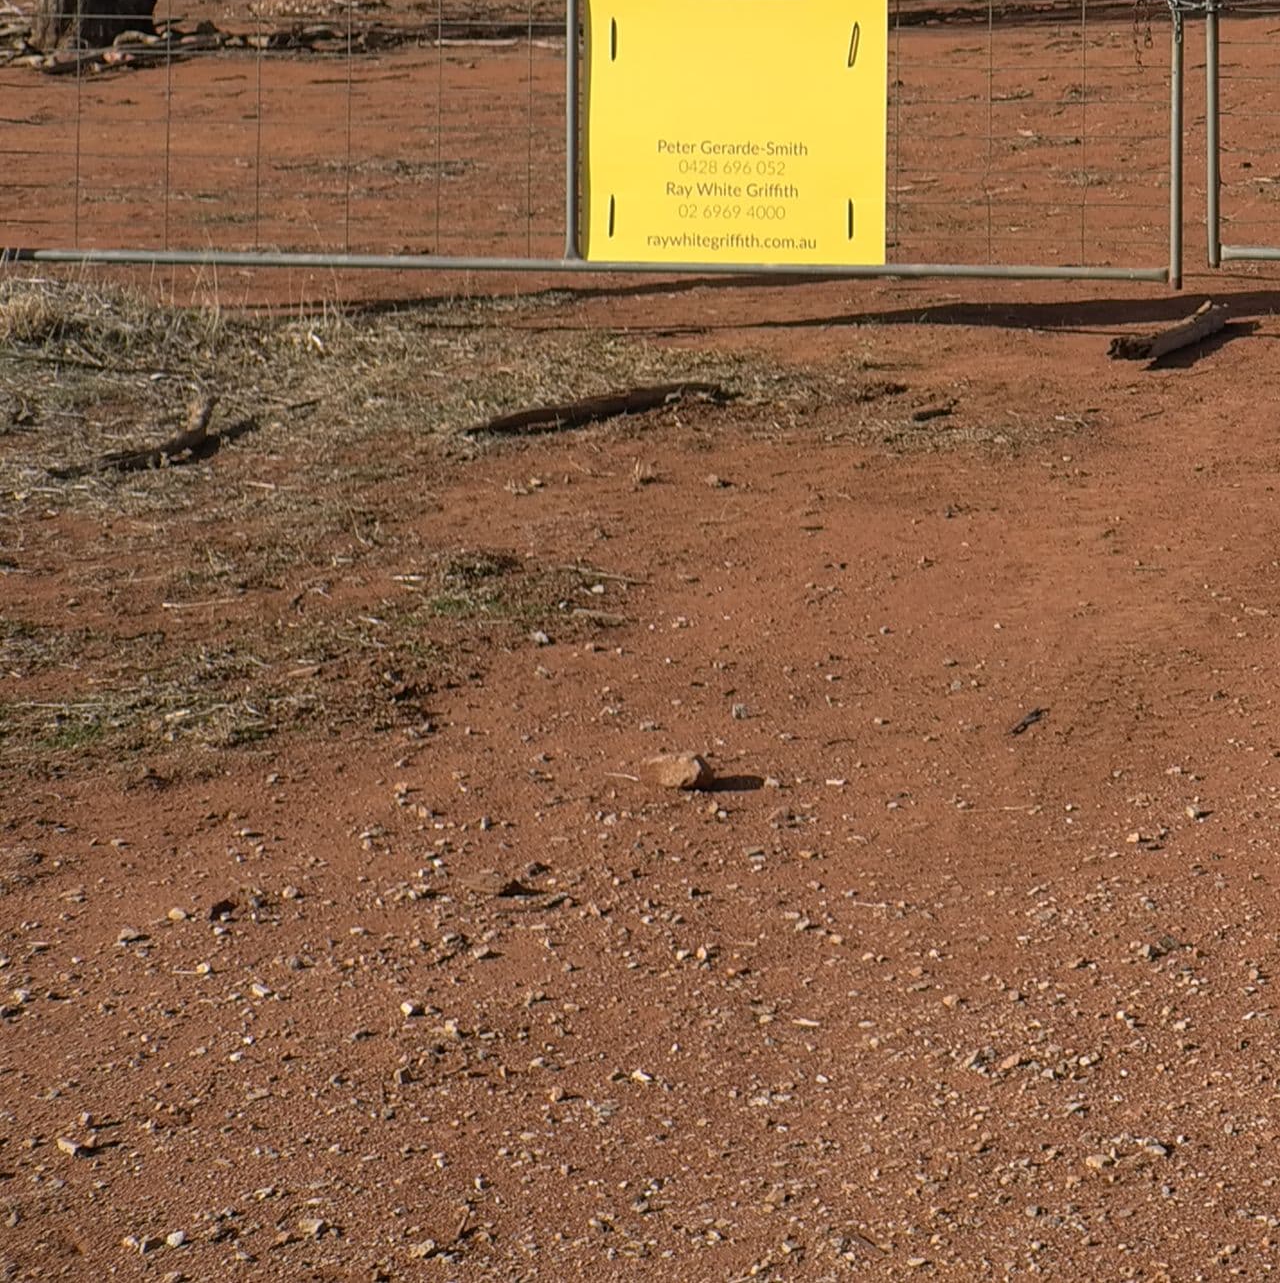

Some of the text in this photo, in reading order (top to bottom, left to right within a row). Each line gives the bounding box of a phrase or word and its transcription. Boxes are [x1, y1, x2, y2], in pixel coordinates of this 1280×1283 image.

[657, 139, 808, 157] Peter Gerarde-Smith
[678, 160, 786, 176] 0428 696 052
[666, 182, 799, 199] Ray White Griffith
[678, 204, 786, 220] 02 6969 4000
[647, 232, 817, 251] raywhitegriffith.com.au
